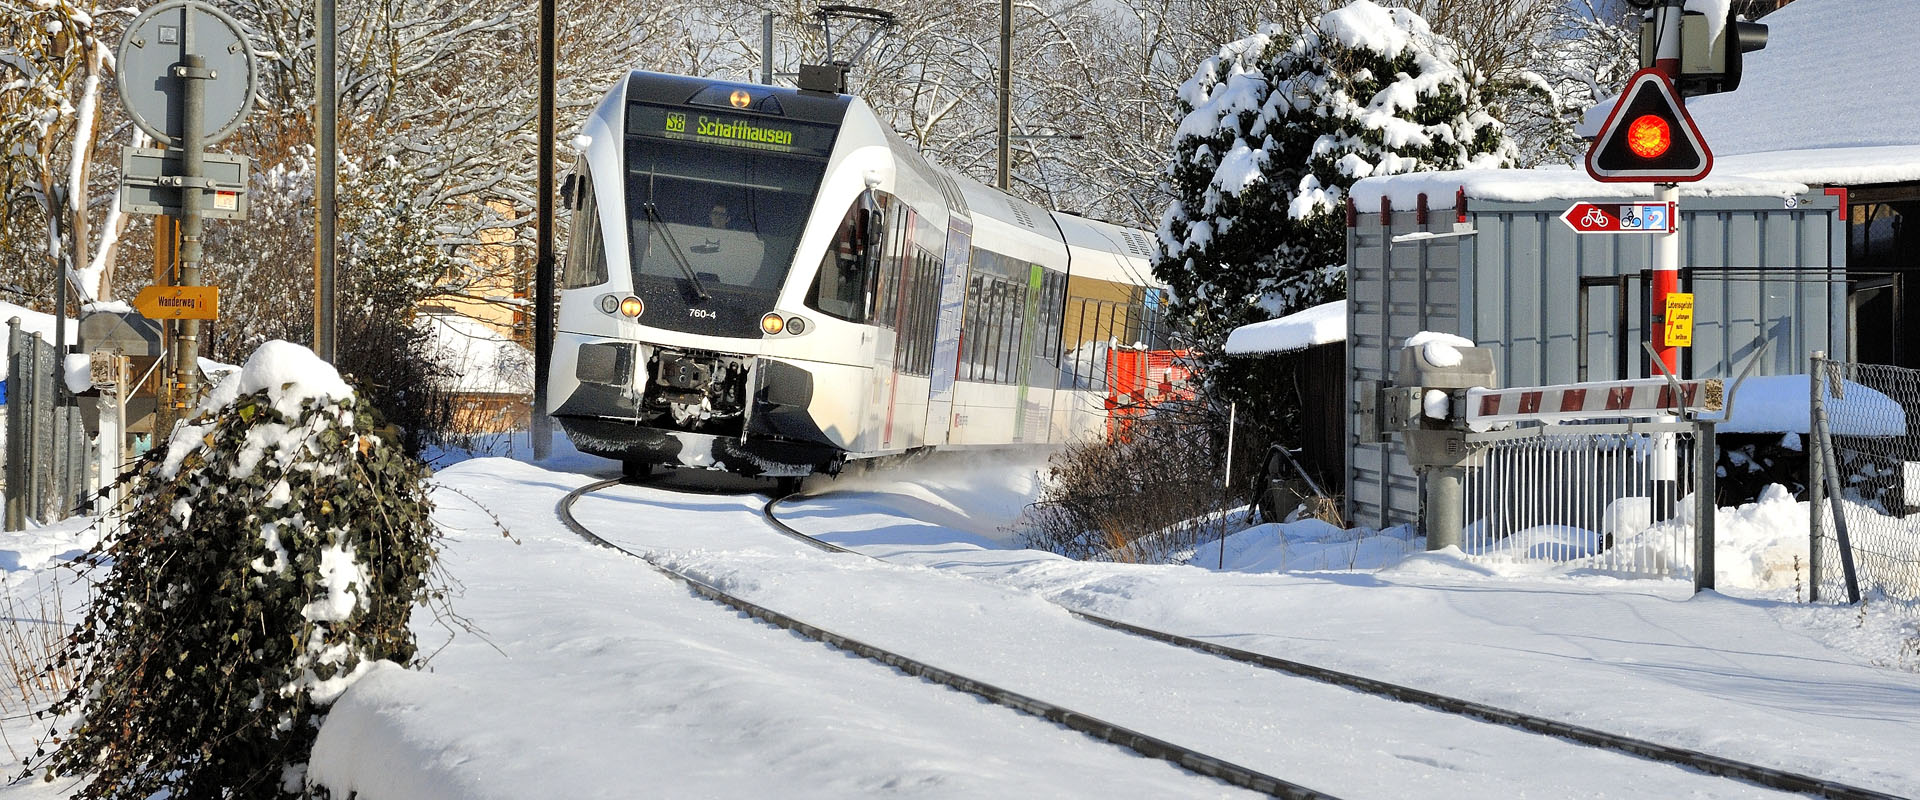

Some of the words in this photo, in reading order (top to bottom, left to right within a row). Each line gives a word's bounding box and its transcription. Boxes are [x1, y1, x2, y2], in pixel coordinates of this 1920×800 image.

[667, 112, 685, 131] S8
[697, 115, 792, 144] Schaffhausen
[1649, 211, 1664, 229] 2
[158, 296, 195, 309] Wanderweg
[689, 309, 716, 319] 760-4
